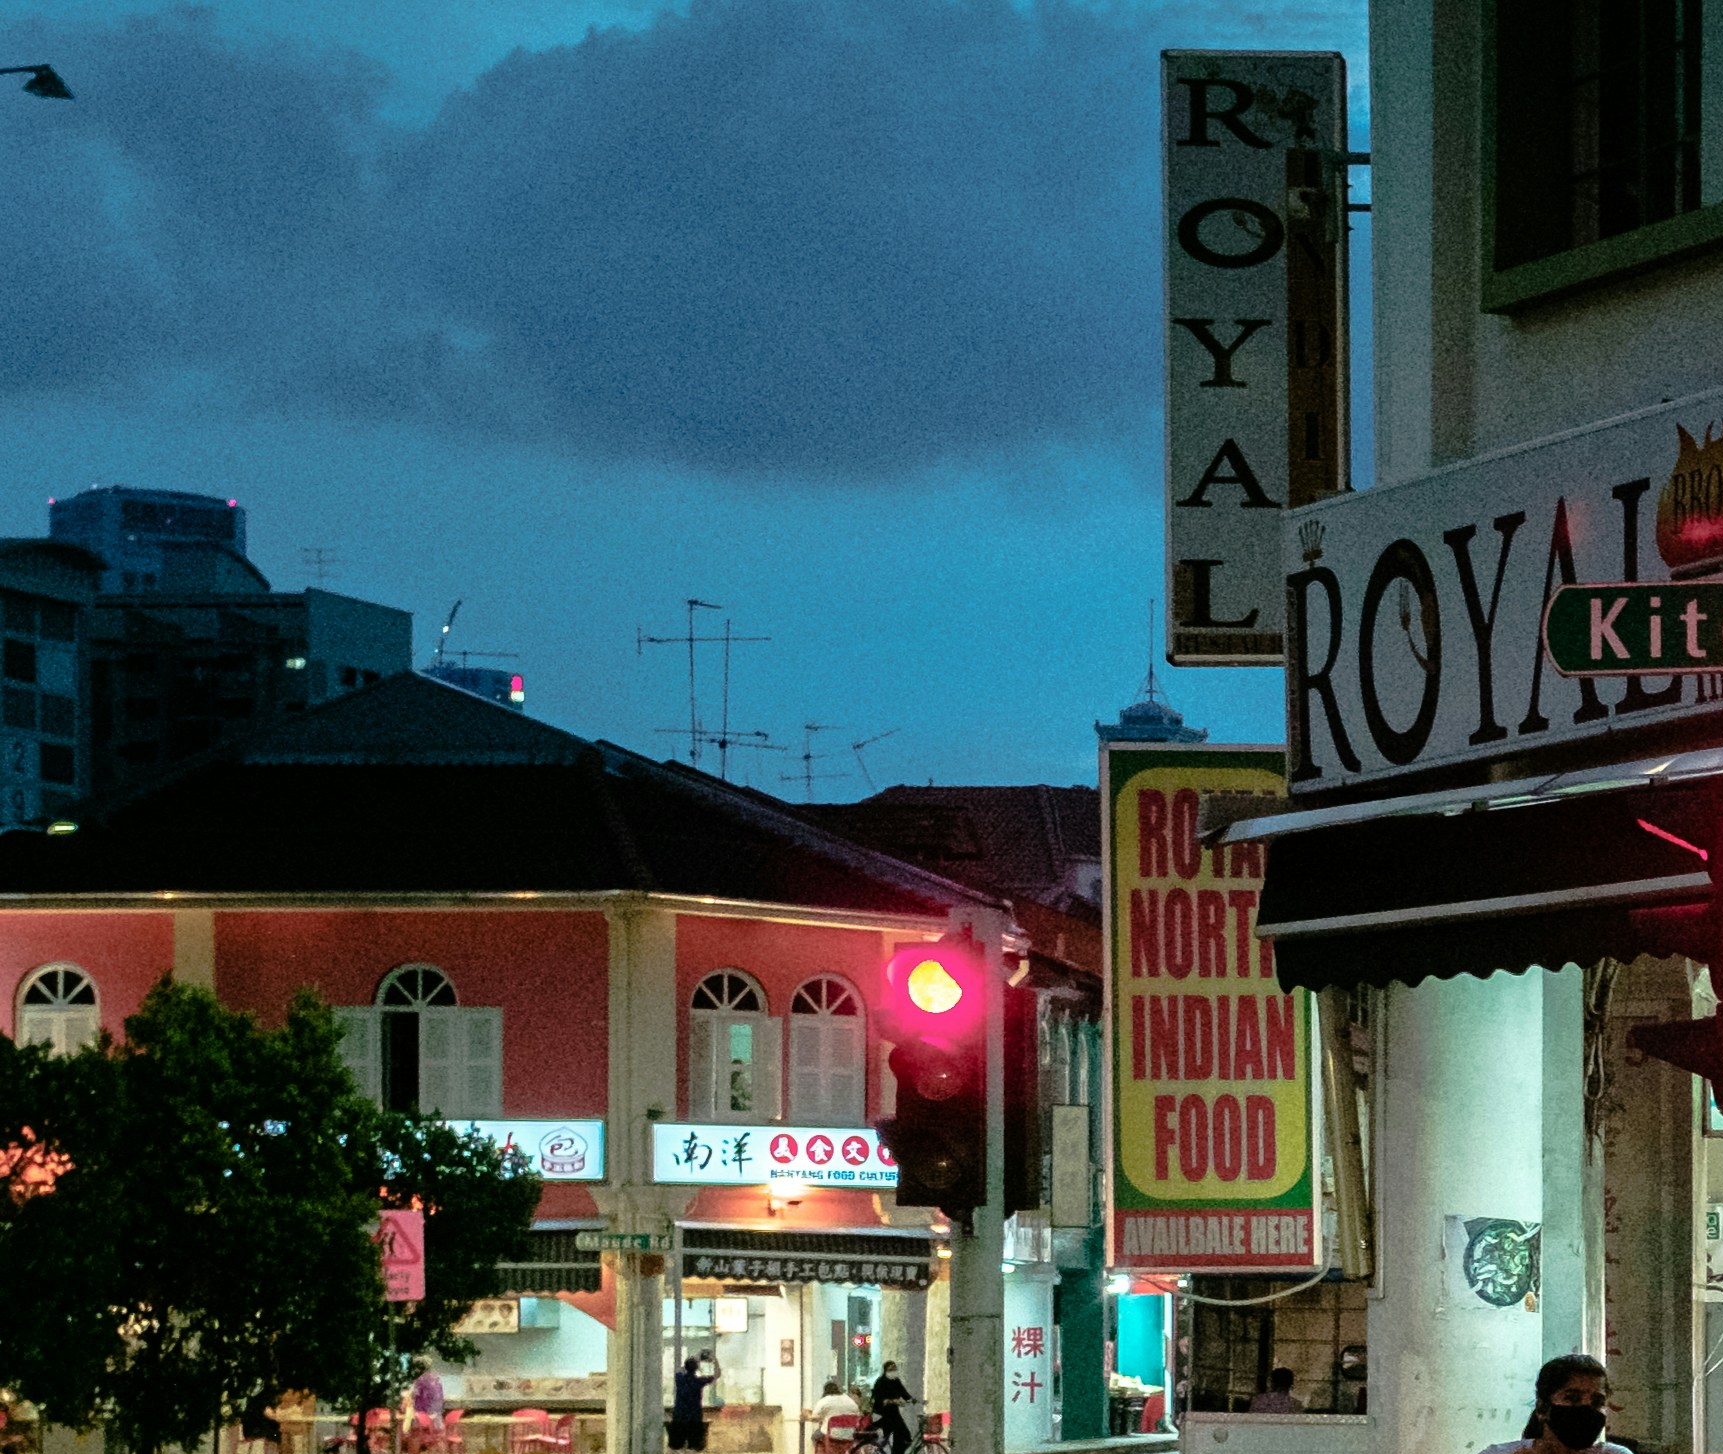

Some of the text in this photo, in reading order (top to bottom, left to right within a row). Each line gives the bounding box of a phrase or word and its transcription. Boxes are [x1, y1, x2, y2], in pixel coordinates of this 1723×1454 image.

[1173, 77, 1285, 628] ROYAL
[1287, 478, 1682, 778] ROYAL
[1132, 994, 1296, 1081] INDIAN
[672, 1131, 898, 1178] 南洋 美食文
[827, 1171, 856, 1181] FOOD
[1154, 1093, 1276, 1182] FOOD
[1251, 1213, 1309, 1255] HERE
